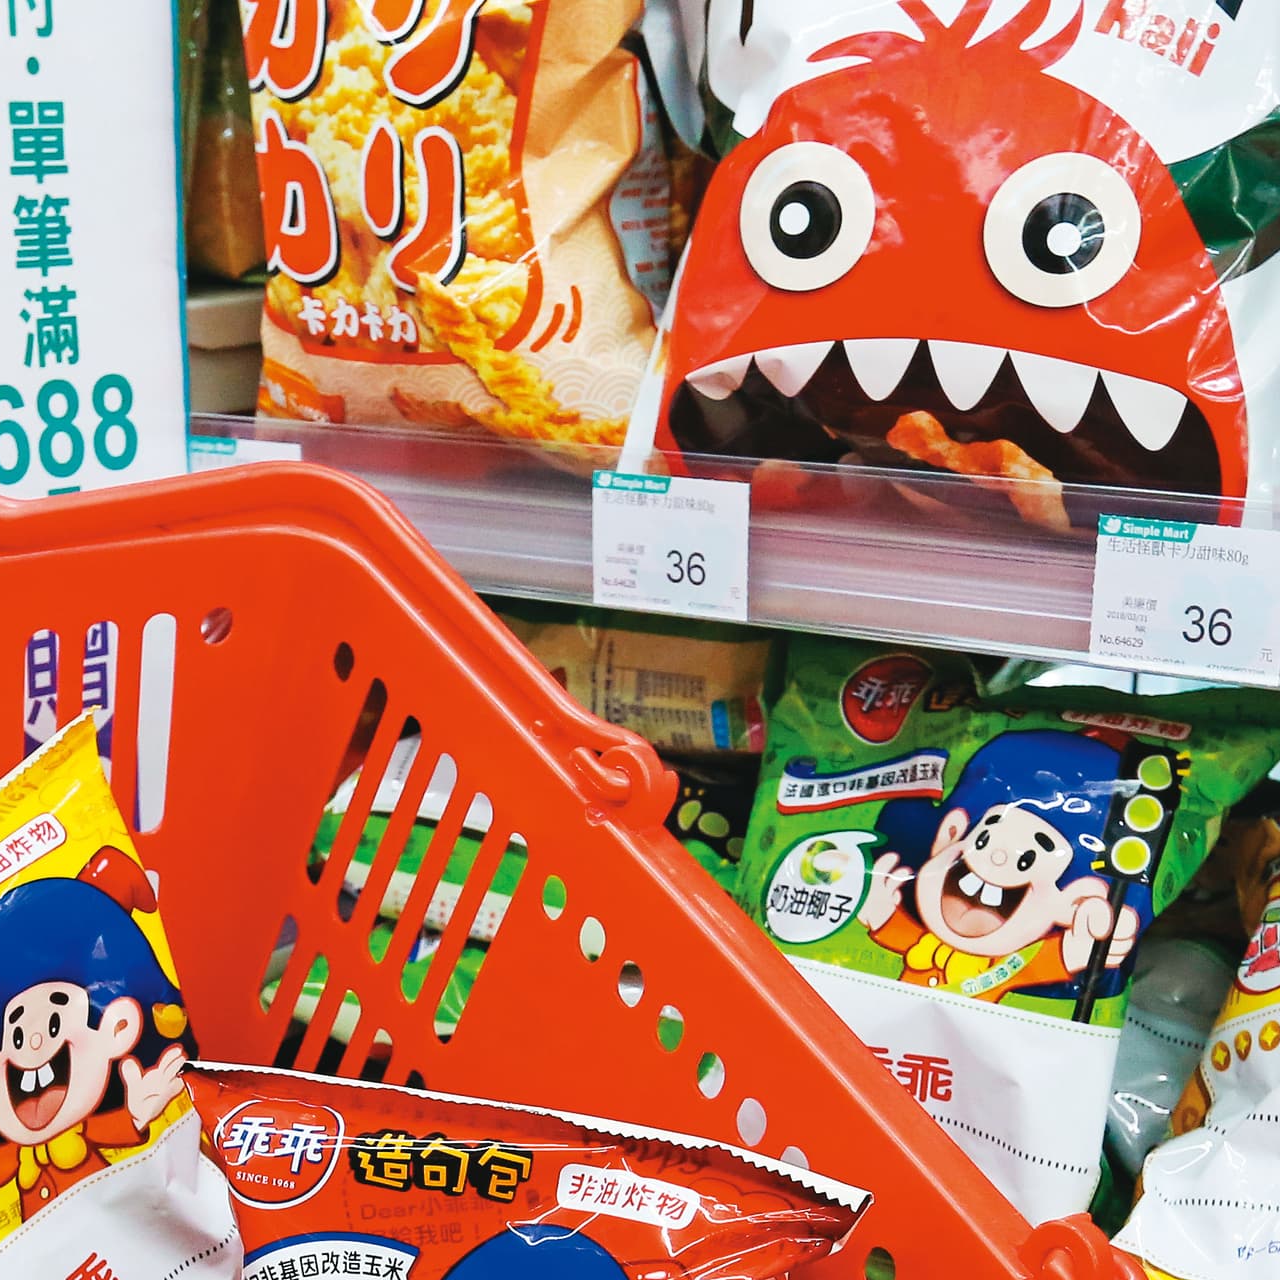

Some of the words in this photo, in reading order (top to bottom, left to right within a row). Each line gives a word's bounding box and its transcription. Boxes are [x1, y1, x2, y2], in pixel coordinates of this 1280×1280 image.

[297, 296, 417, 344] 卡力卡力
[1123, 524, 1160, 537] Simple
[1163, 528, 1189, 540] Mart
[666, 550, 706, 586] 36
[1099, 634, 1144, 648] No.64629
[1182, 605, 1233, 646] 36
[1261, 648, 1273, 663] 元
[770, 884, 853, 924] 奶油椰子
[222, 1116, 331, 1175] 乖乖
[235, 1171, 269, 1186] SINCE
[272, 1177, 296, 1190] 1968
[357, 1133, 532, 1200] 造句包
[569, 1173, 689, 1221] 非油炸物
